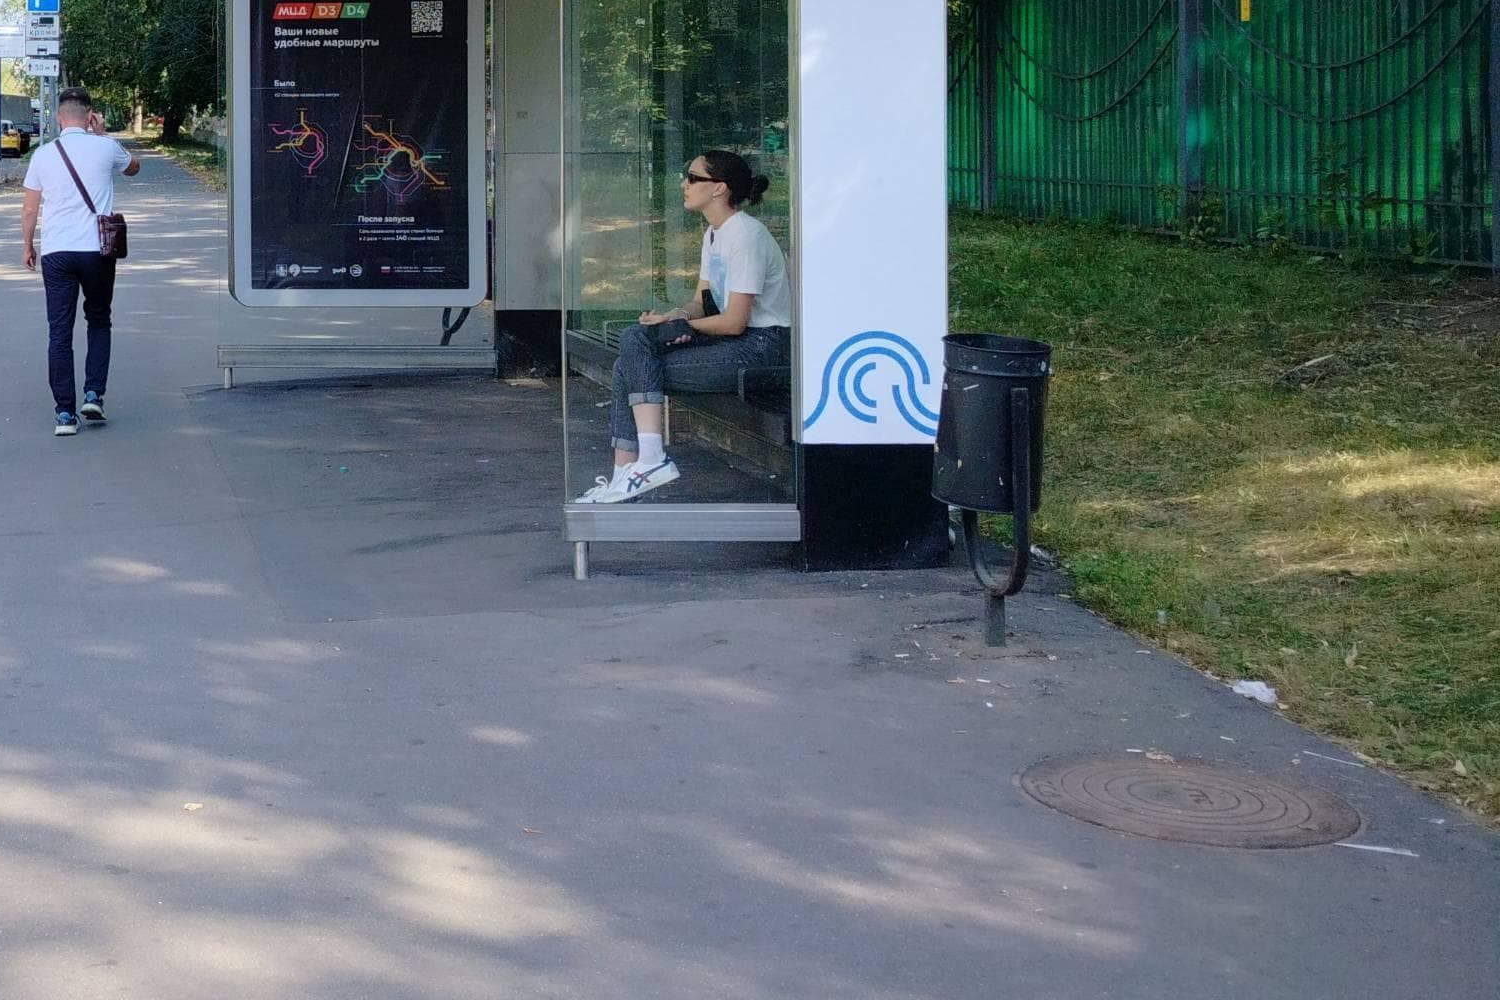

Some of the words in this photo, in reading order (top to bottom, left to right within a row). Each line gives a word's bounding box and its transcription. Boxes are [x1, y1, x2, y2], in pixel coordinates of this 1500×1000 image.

[317, 5, 337, 16] D3
[346, 5, 365, 16] D4
[274, 26, 303, 36] Ваши
[305, 27, 339, 36] новые
[274, 38, 320, 49] удобные
[322, 38, 380, 49] маршруты
[274, 79, 296, 87] Было
[357, 215, 383, 223] После
[384, 216, 415, 224] запуска
